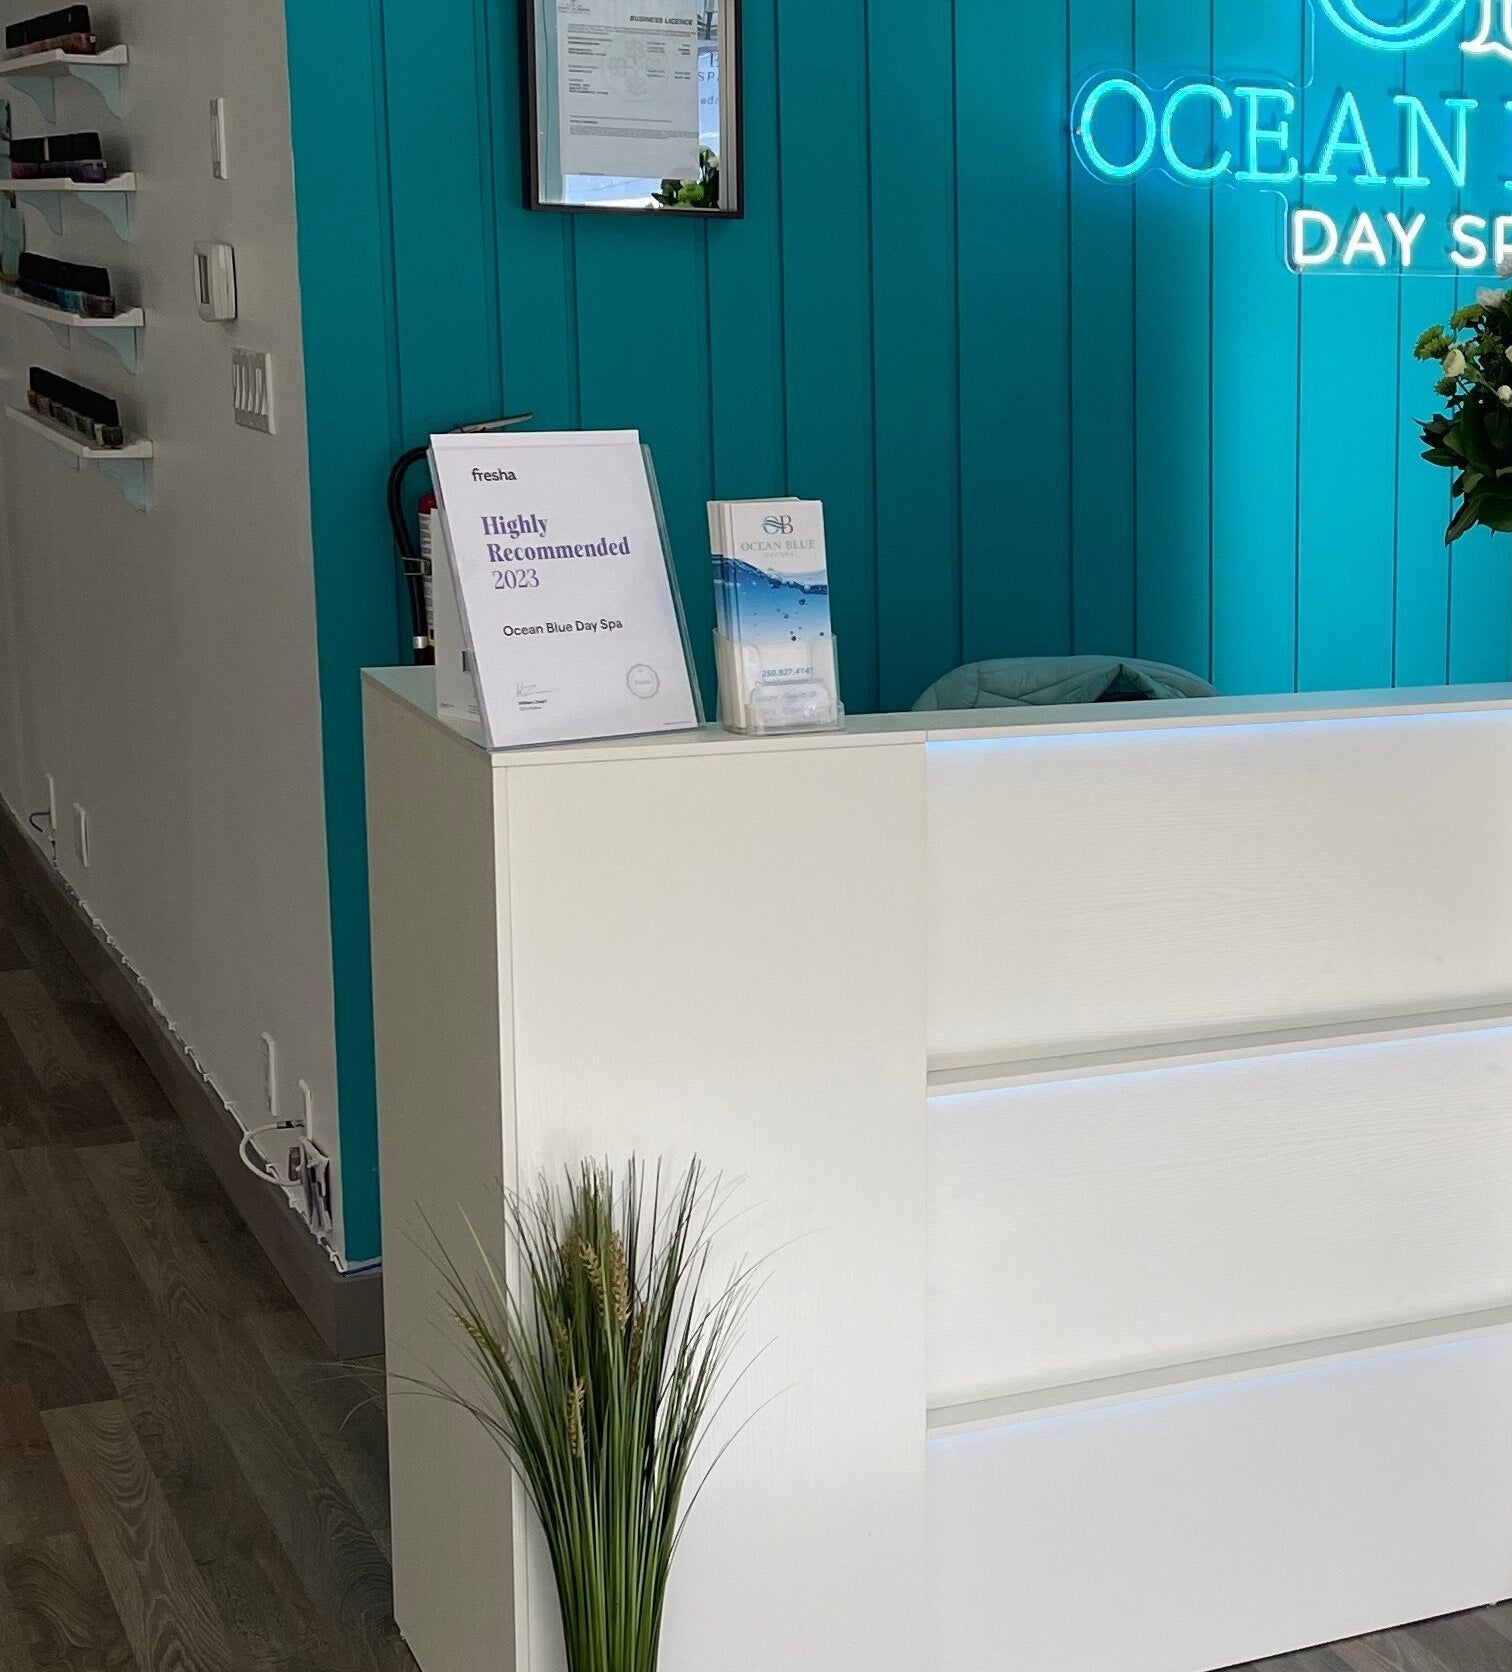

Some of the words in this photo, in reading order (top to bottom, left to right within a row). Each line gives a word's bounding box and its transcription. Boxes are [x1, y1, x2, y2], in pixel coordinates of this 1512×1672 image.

[630, 15, 663, 24] BUSINESS
[664, 18, 694, 26] LICENCE
[1081, 79, 1478, 187] OCEAN
[1292, 209, 1427, 268] DAY
[471, 467, 518, 482] fresha
[480, 513, 549, 540] Highly
[486, 536, 631, 563] Recommended
[740, 541, 783, 552] OCEAN
[785, 539, 817, 550] BLUE
[492, 568, 541, 590] 2023
[502, 624, 544, 637] Ocean
[546, 622, 573, 634] Blue
[575, 620, 598, 633] Day
[600, 618, 623, 632] Spa
